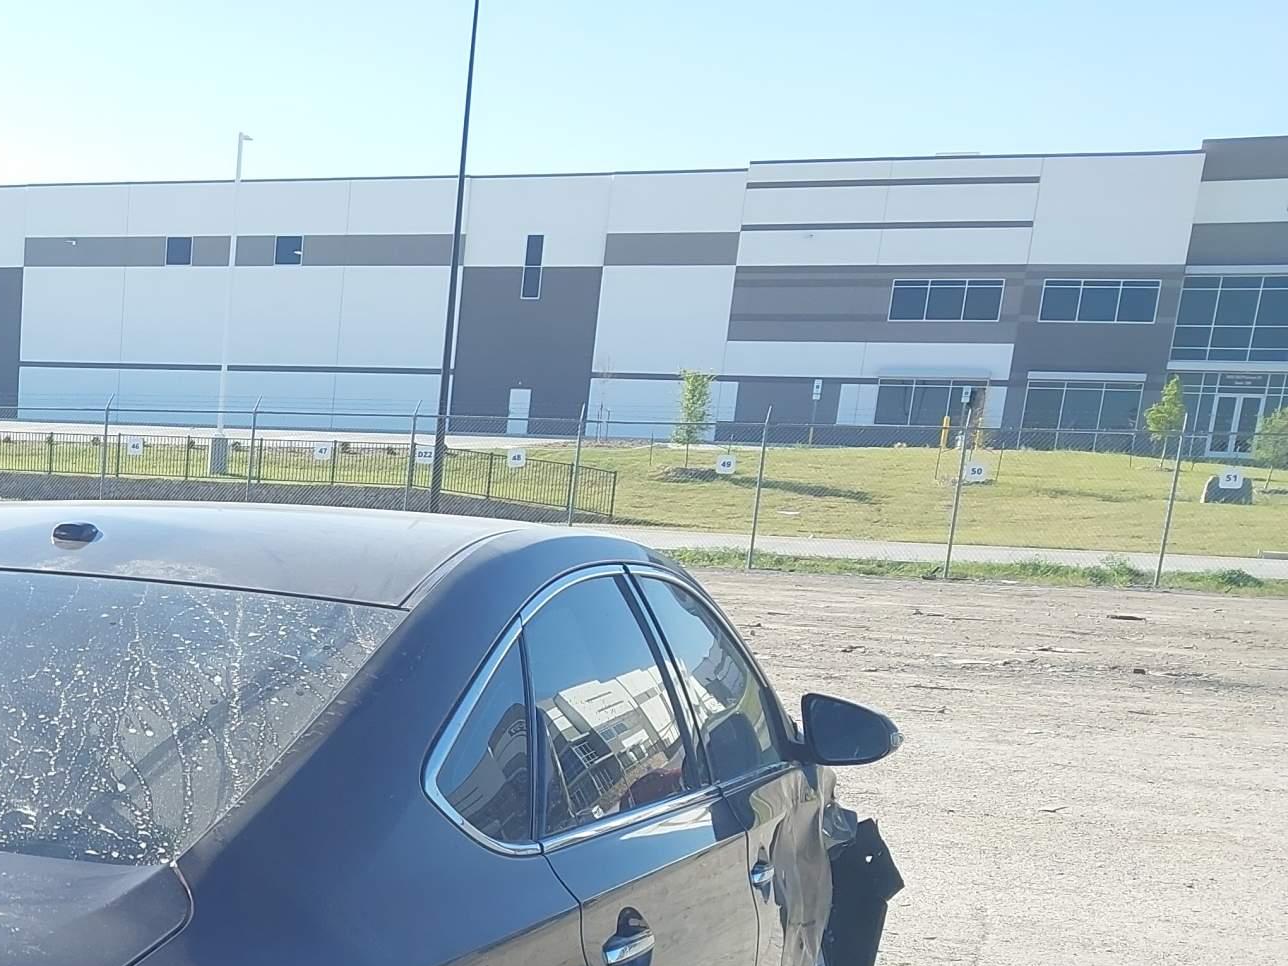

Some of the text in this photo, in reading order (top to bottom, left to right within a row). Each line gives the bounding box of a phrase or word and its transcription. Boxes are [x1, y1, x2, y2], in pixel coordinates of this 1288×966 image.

[721, 460, 732, 468] 49
[971, 467, 983, 475] 50
[1225, 474, 1237, 482] 51
